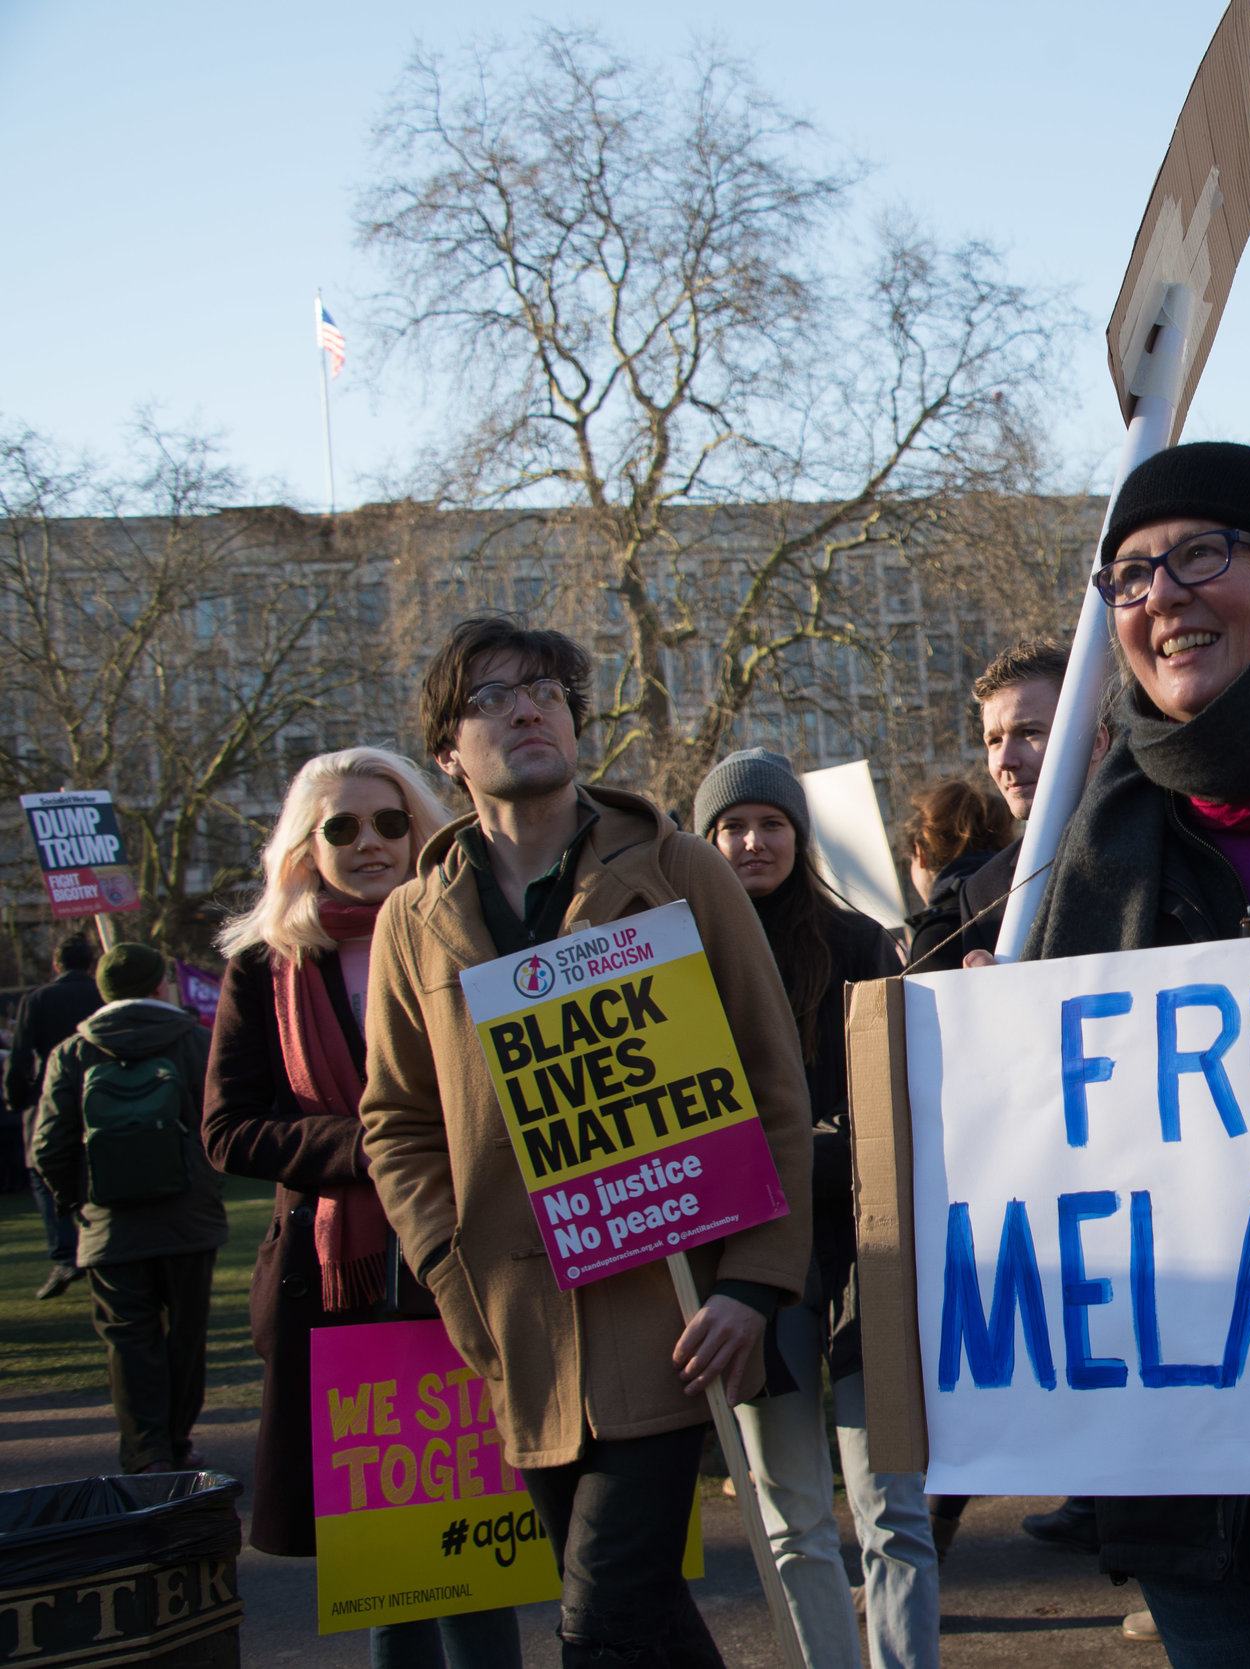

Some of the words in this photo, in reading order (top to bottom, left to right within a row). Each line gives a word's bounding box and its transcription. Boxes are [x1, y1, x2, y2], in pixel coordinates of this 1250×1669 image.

[31, 806, 100, 839] DUMP
[38, 833, 120, 869] TRUMP
[48, 873, 79, 888] FIGHT
[52, 885, 98, 903] BIGOTRY
[555, 936, 610, 967] STAND
[612, 927, 637, 948] UP
[561, 964, 585, 985] TO
[587, 942, 655, 977] RACISM
[489, 974, 668, 1075] BLACK
[505, 1037, 657, 1127] LIVES
[522, 1067, 743, 1179] MATTER
[542, 1190, 591, 1226] No
[593, 1155, 704, 1217] justice
[553, 1223, 602, 1260] No
[606, 1193, 701, 1249] peace
[580, 1239, 665, 1274] standuptoracism.org.uk
[680, 1213, 740, 1241] @AntiRacismDay
[327, 1378, 402, 1443] WE
[331, 1595, 386, 1617] AMNESTY
[388, 1583, 473, 1609] INTERNATIONAL
